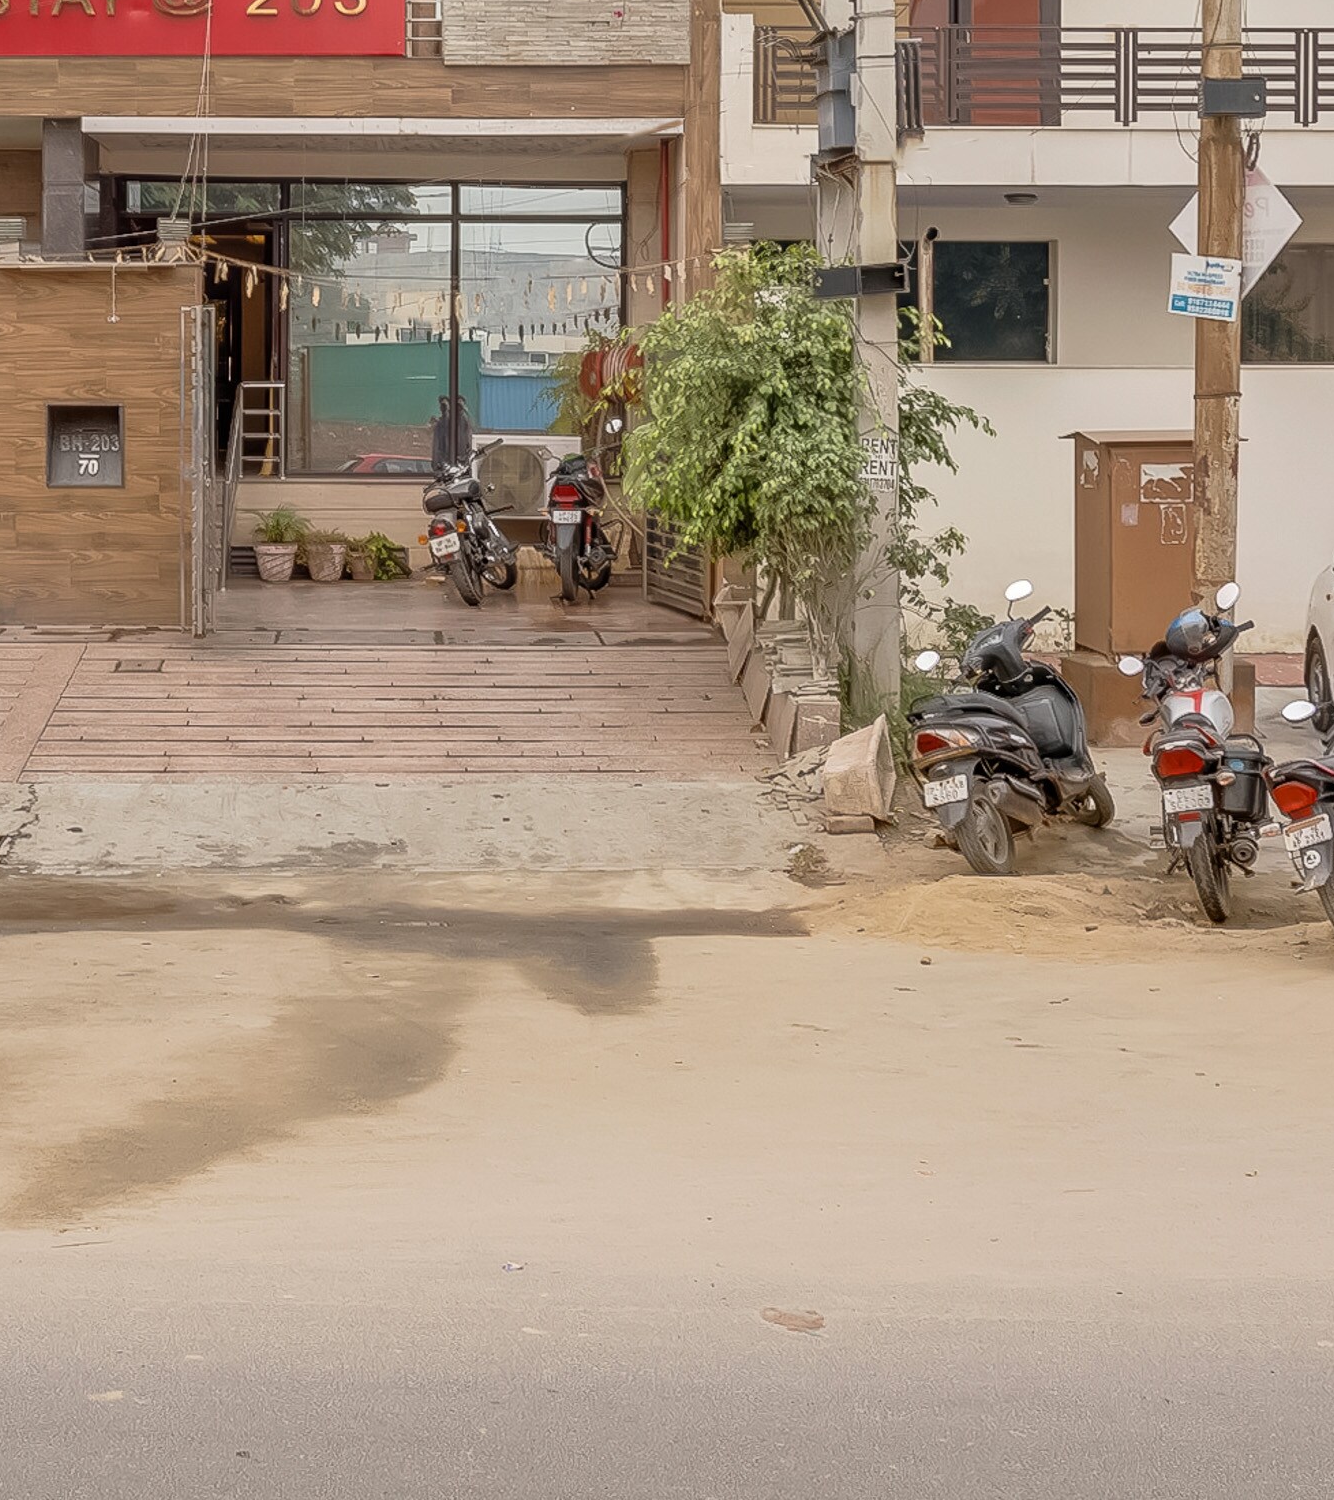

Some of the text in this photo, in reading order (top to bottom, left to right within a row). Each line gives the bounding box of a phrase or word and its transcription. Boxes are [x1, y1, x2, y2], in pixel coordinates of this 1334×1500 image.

[861, 437, 898, 455] RENT
[78, 460, 99, 475] 70
[859, 460, 898, 476] RENT
